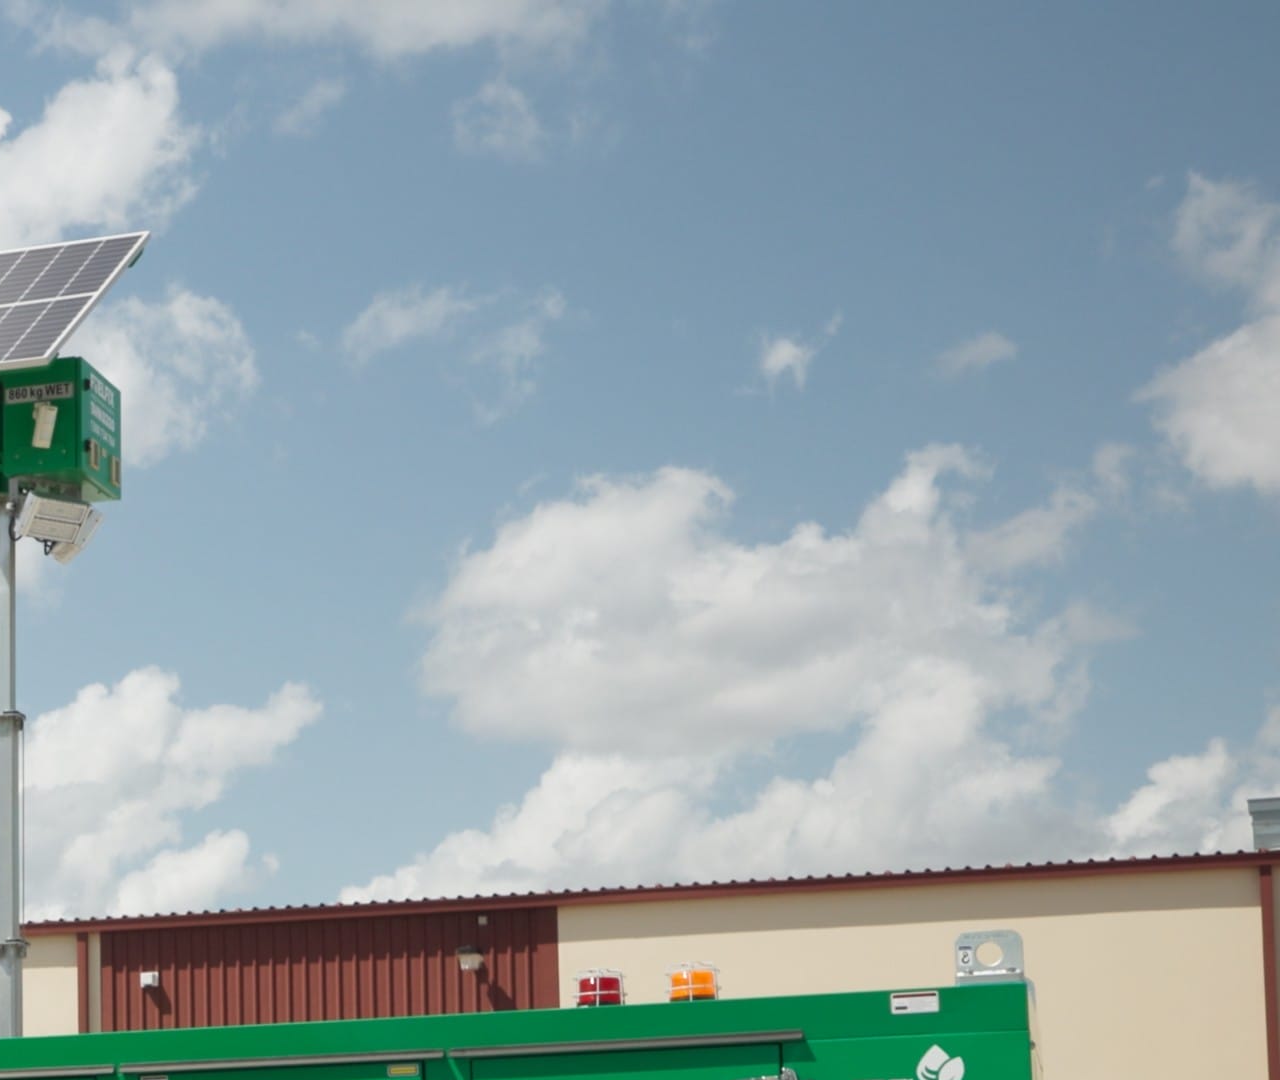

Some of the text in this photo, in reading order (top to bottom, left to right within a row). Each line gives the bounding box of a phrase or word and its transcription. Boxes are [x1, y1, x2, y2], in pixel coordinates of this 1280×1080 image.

[9, 383, 70, 400] 860 kg WET
